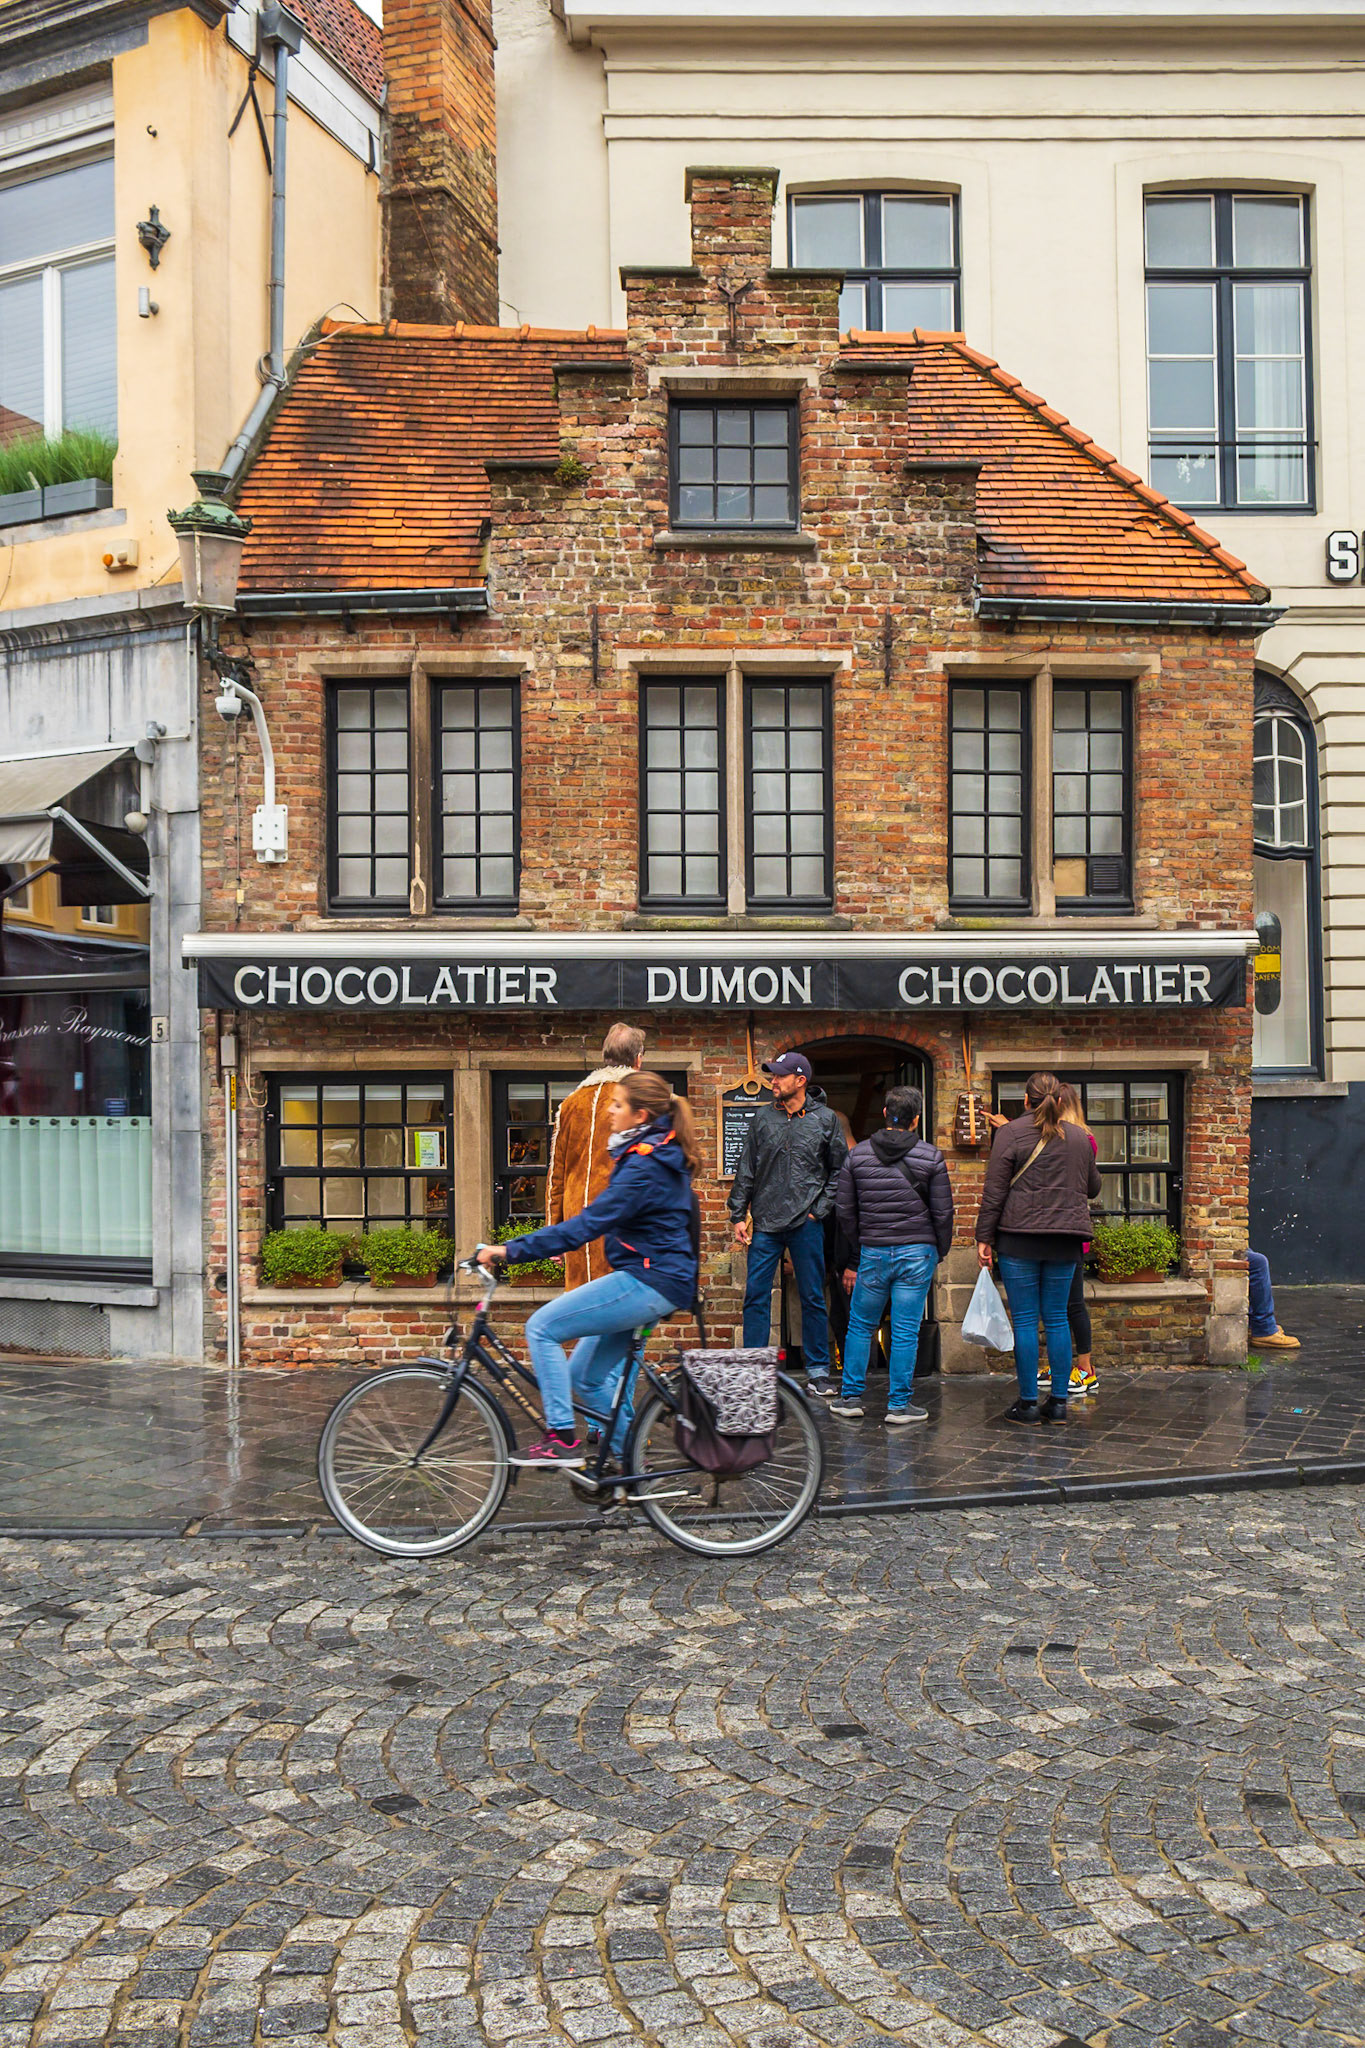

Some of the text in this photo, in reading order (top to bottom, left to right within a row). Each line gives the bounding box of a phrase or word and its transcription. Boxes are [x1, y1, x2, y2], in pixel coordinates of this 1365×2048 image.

[1326, 530, 1365, 586] S
[1260, 945, 1281, 954] OOM
[233, 963, 1213, 1005] CHOCOLATIER DUMON CHOCOLATIER
[57, 1005, 152, 1048] Raymond
[157, 1023, 163, 1038] 5
